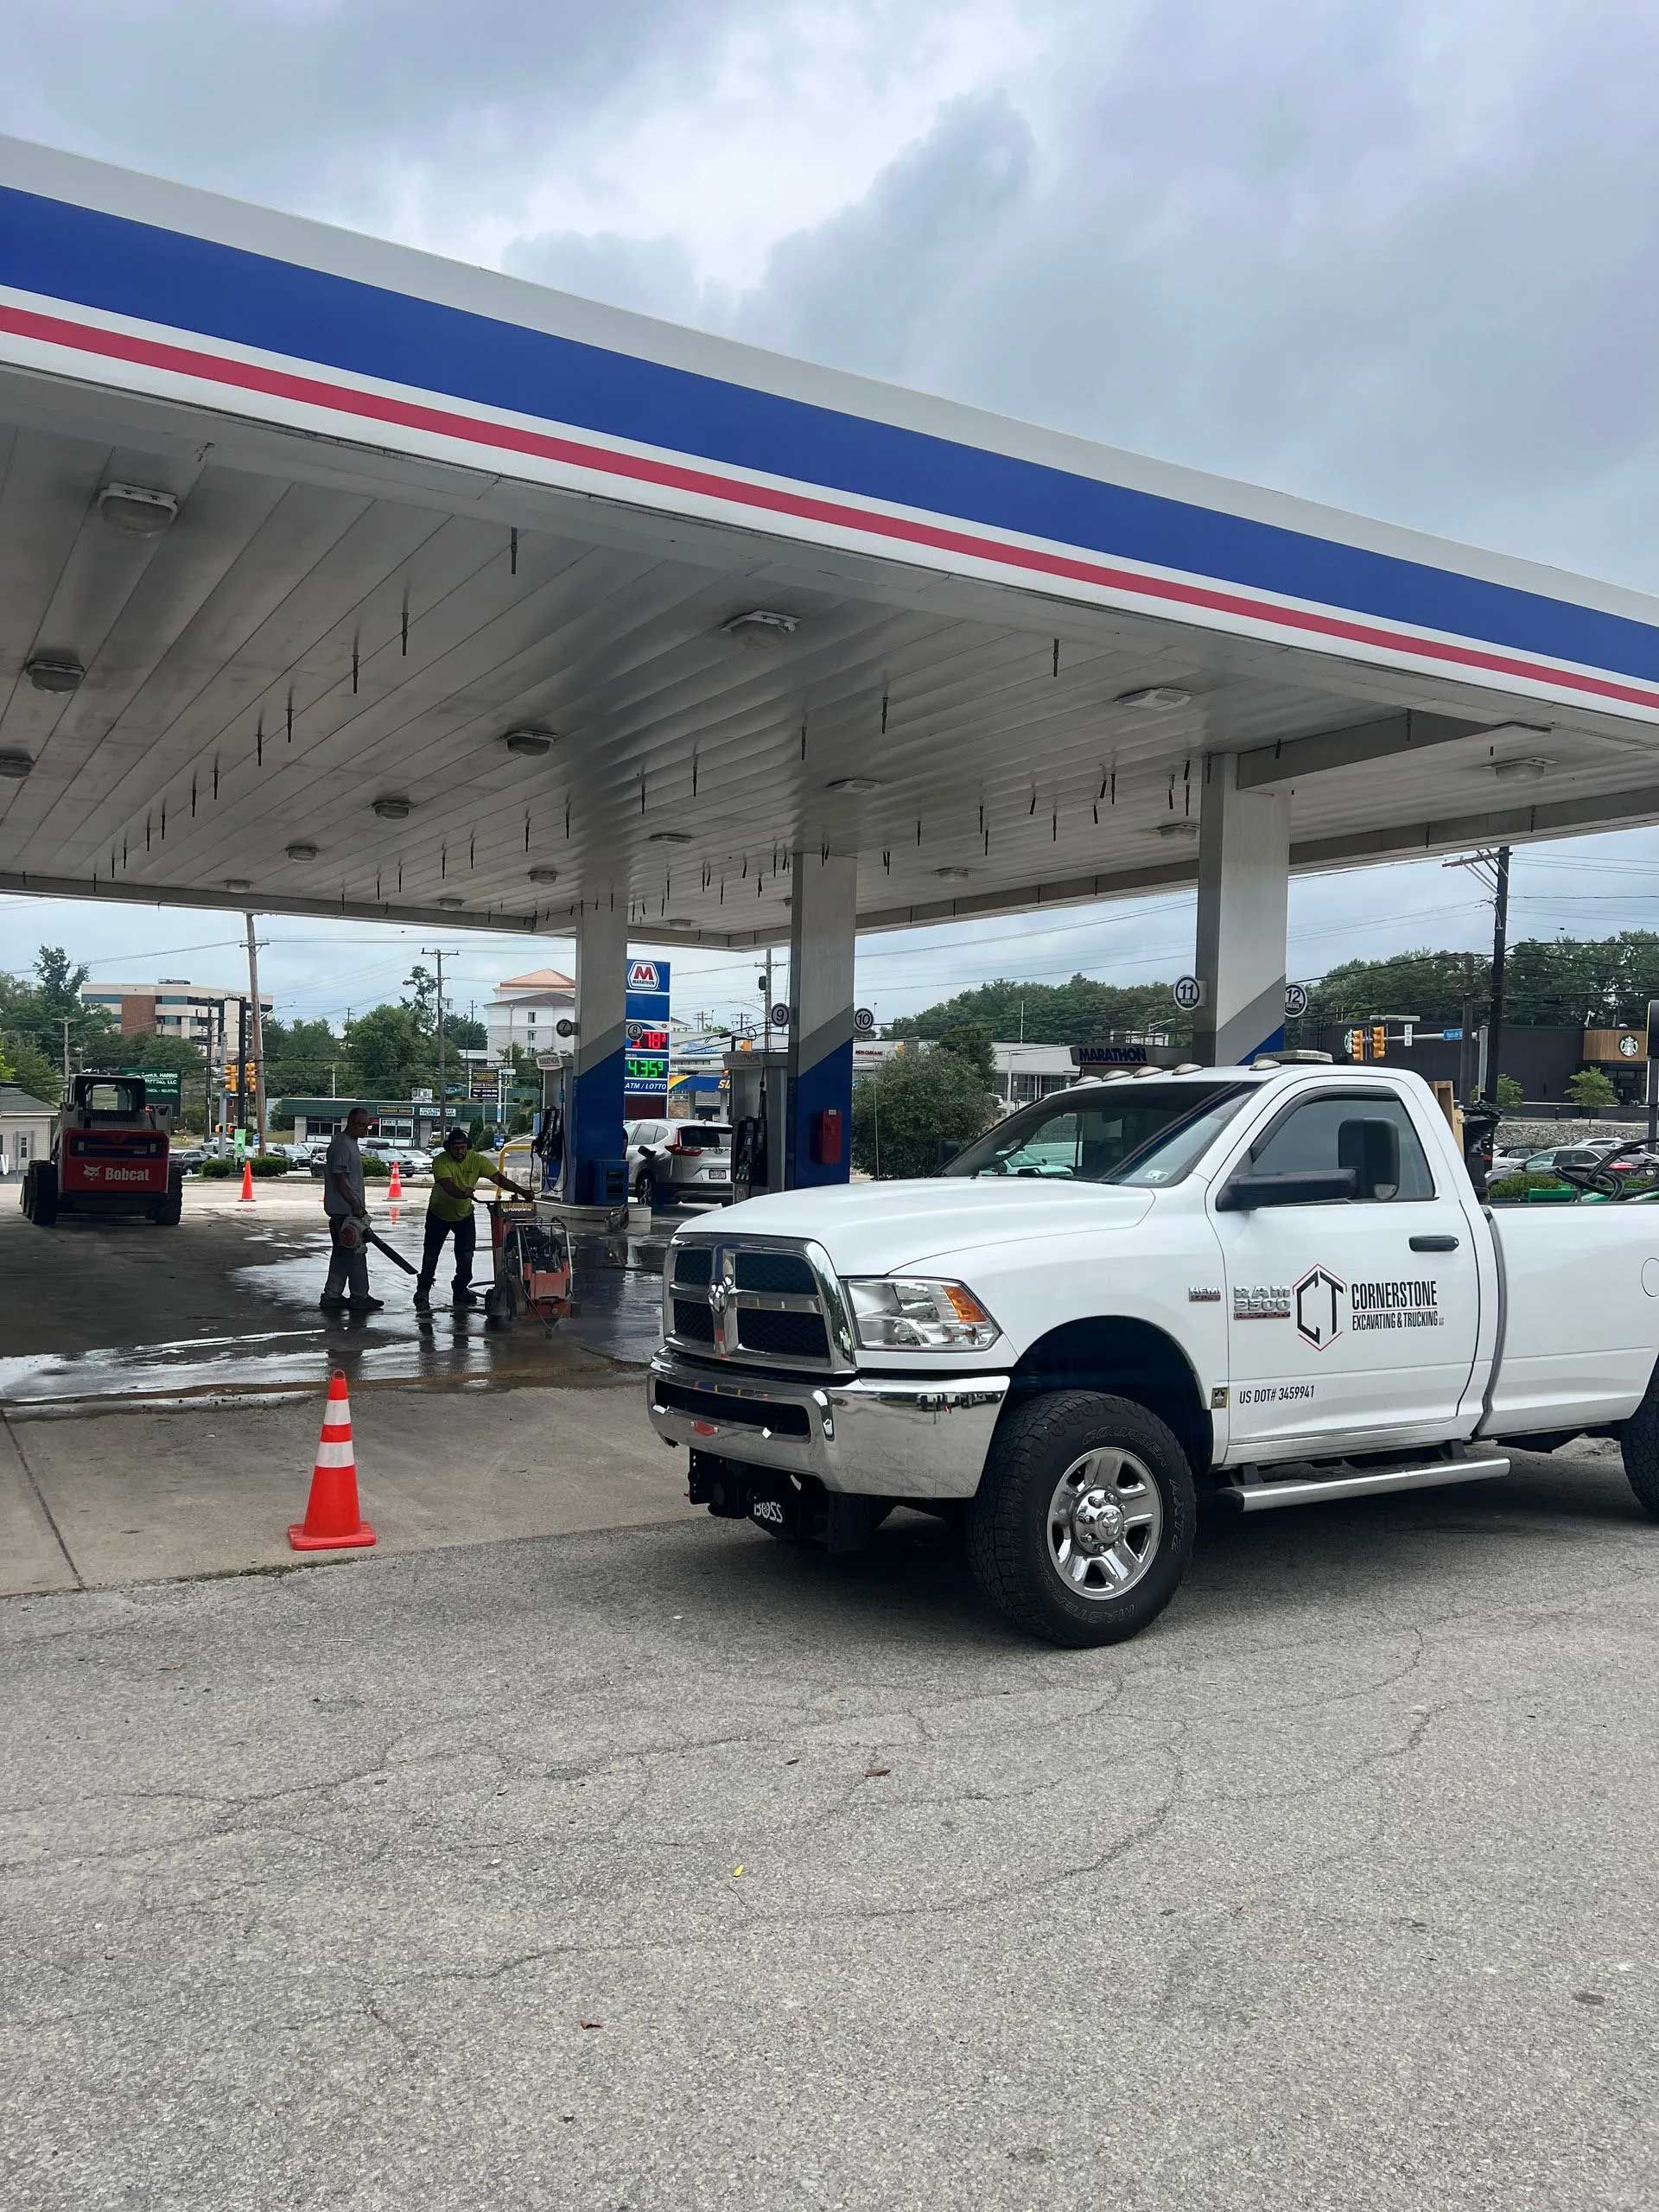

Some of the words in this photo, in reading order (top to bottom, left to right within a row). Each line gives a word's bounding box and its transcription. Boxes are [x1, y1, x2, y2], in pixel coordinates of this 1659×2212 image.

[1179, 984, 1194, 999] 11
[1286, 989, 1300, 1002] 12
[777, 1009, 784, 1021] 9
[857, 1014, 870, 1026] 10
[563, 1022, 568, 1031] 7
[1078, 1047, 1147, 1062] MARATHON
[105, 1166, 149, 1181] Bobcat
[1233, 1285, 1291, 1299] RAM
[1351, 1281, 1438, 1311] CORNERSTONE
[1233, 1298, 1291, 1312] 2500
[1352, 1314, 1395, 1332] EXCAVATING
[1396, 1313, 1402, 1329] &
[1403, 1311, 1438, 1327] TRUCKING
[1239, 1390, 1252, 1404] US
[1254, 1388, 1277, 1403] DOT#
[1278, 1385, 1314, 1401] 3459941
[753, 1501, 783, 1523] BOSS
